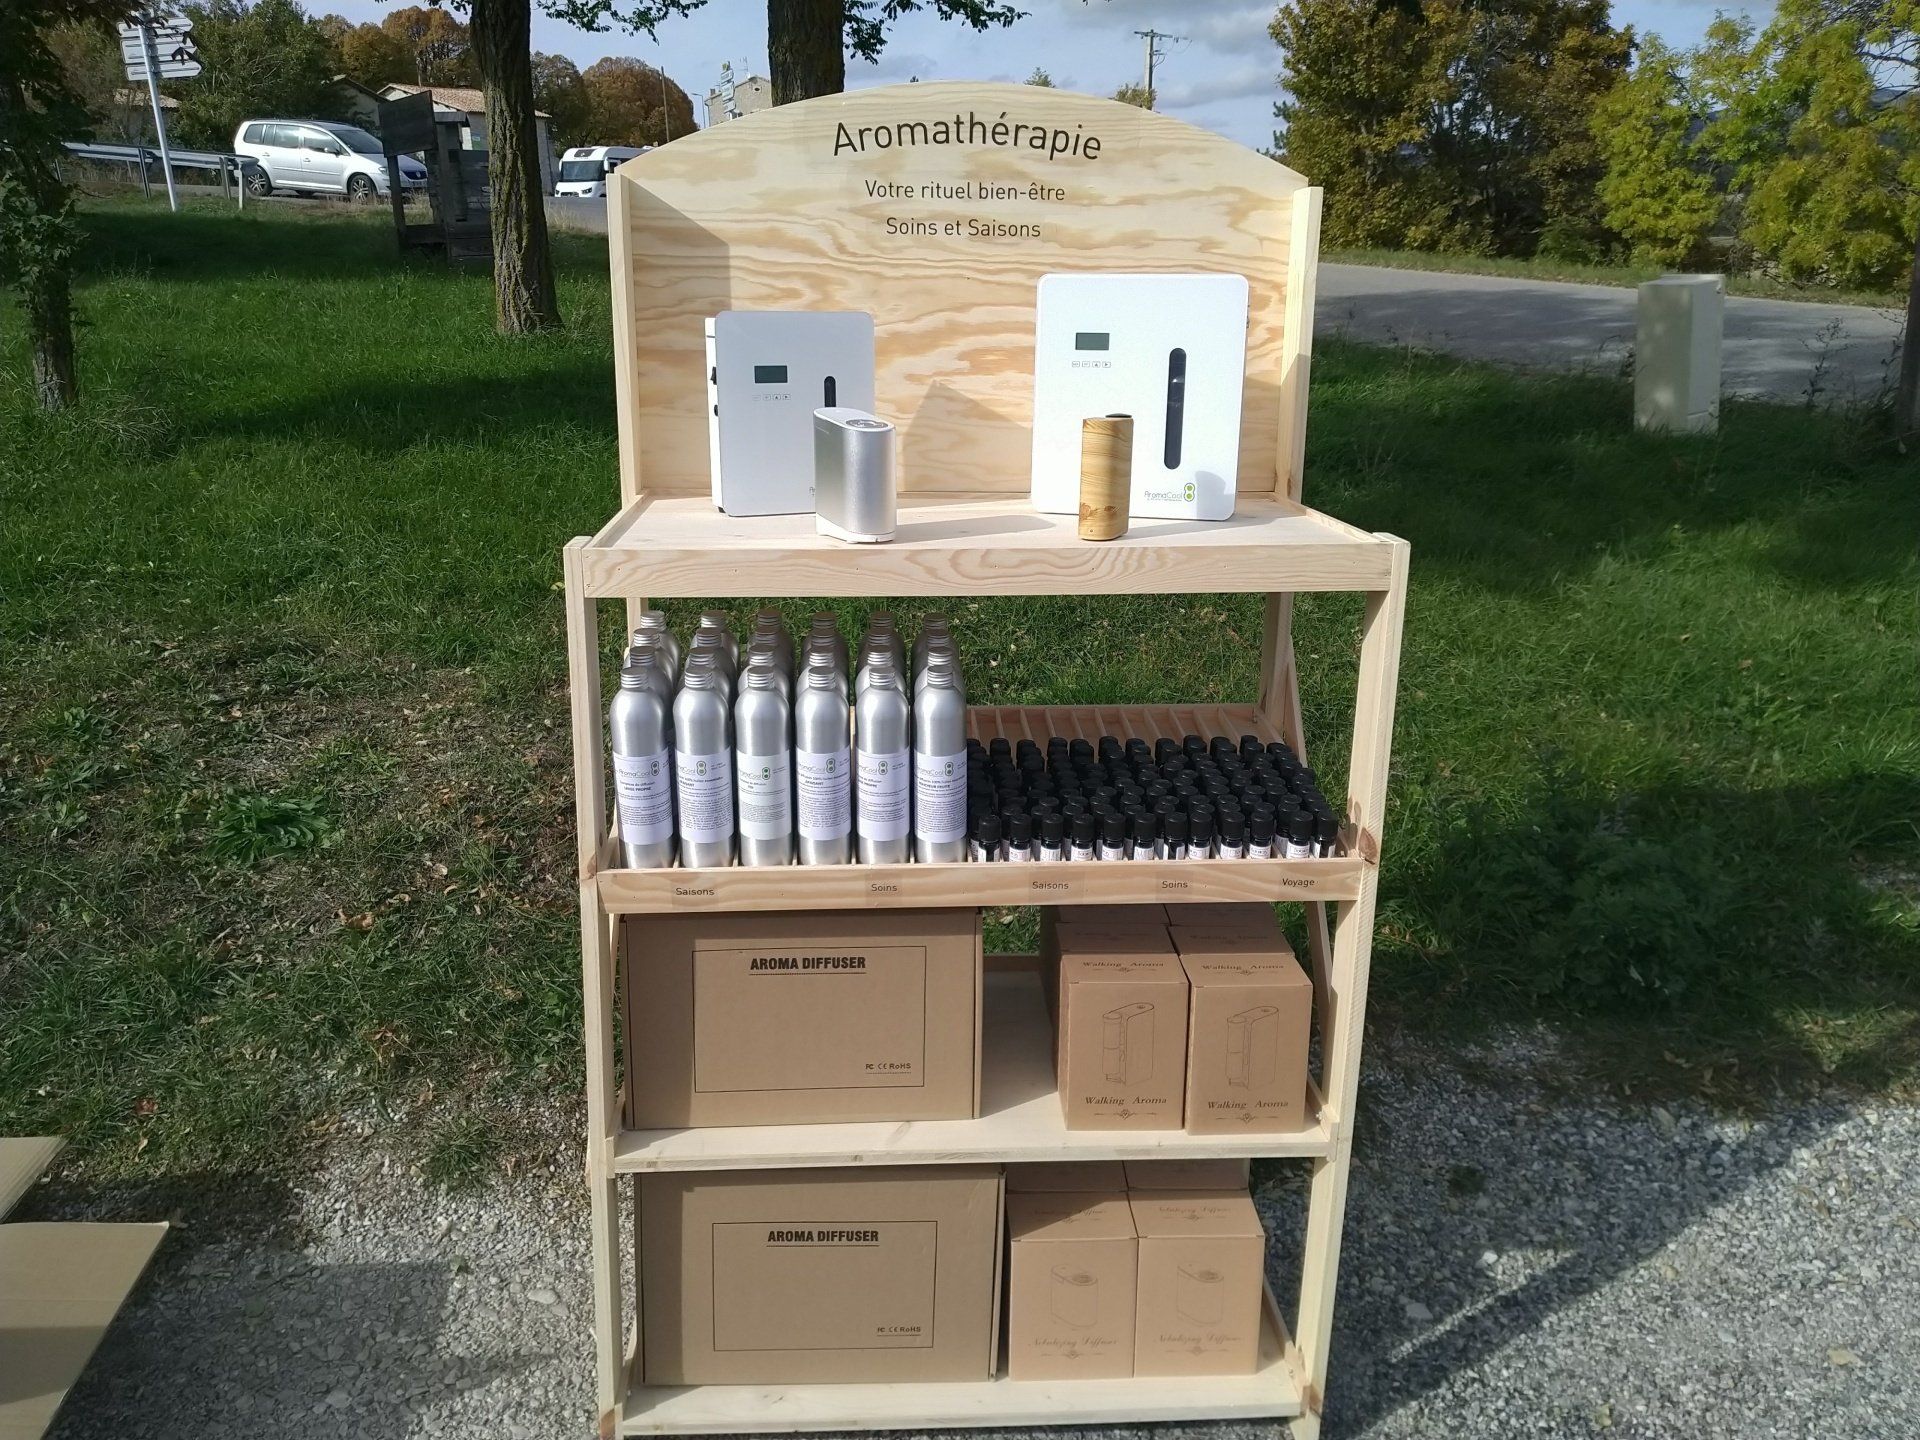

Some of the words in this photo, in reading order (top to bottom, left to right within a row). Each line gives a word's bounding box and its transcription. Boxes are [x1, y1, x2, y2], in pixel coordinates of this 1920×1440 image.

[833, 111, 1102, 161] Aromathérapie
[865, 179, 915, 199] Votre
[921, 180, 972, 200] rituel
[979, 181, 1066, 201] bien-être
[886, 217, 938, 236] Soins
[944, 219, 962, 237] et
[968, 219, 1041, 238] Saisons
[871, 883, 898, 892] Soins
[1032, 880, 1069, 890] Saisons
[1162, 879, 1188, 889] Soins
[1281, 877, 1316, 888] Voyage
[675, 887, 715, 896] Saisons
[750, 957, 799, 971] AROMA
[802, 956, 866, 970] DIFFUSER
[889, 1062, 911, 1070] RoHS
[1085, 1096, 1125, 1106] Walking
[1133, 1096, 1167, 1105] Aroma
[1207, 1101, 1247, 1110] Walking
[768, 1230, 815, 1243] AROMA
[818, 1230, 879, 1243] DIFFUSER
